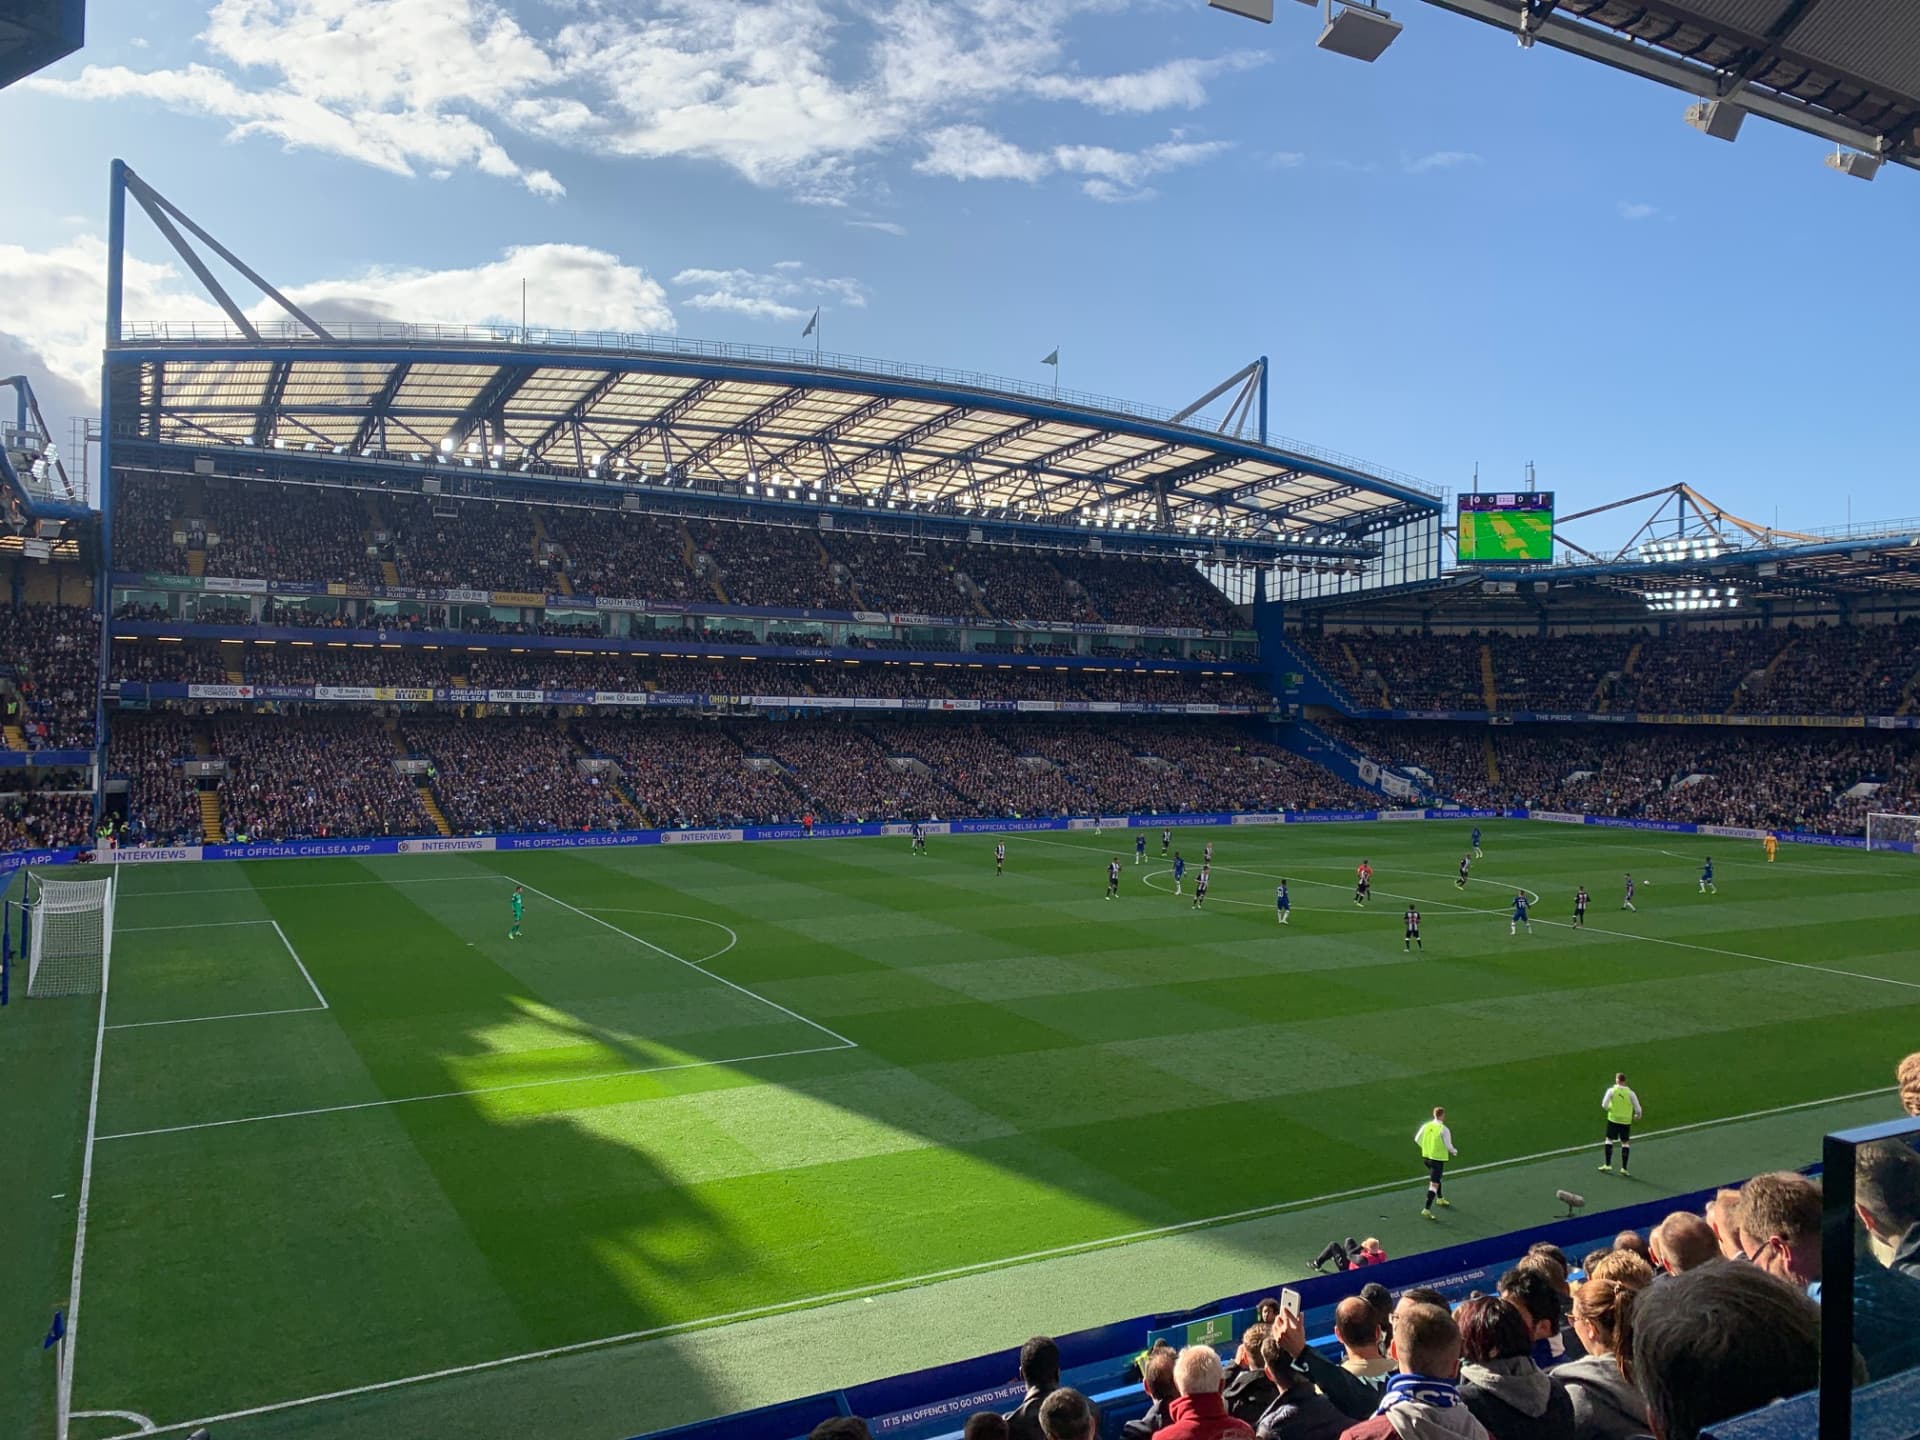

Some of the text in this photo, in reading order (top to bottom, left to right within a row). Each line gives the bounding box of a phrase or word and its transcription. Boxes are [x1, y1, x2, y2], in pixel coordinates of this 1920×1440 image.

[597, 598, 623, 606] SOUTH
[625, 599, 645, 608] WEST
[900, 616, 922, 624] MALTA
[709, 695, 728, 703] OHIO
[681, 832, 732, 841] INTERVIEWS
[1797, 836, 1831, 845] OFFICIAL
[422, 841, 482, 850] INTERVIEWS
[513, 840, 531, 848] THE
[533, 838, 575, 847] OFFICIAL
[578, 837, 618, 846] CHELSEA
[114, 850, 186, 861] INTERVIEWS
[223, 844, 370, 857] THE OFFICIAL CHELSEA APP
[30, 855, 52, 865] APP
[883, 1418, 891, 1428] IT
[892, 1417, 900, 1426] IS
[902, 1414, 913, 1423] AN
[913, 1404, 947, 1420] OFFENCE
[948, 1402, 959, 1411] TO
[960, 1398, 972, 1408] GO
[973, 1393, 993, 1404] ONTO
[995, 1389, 1009, 1399] THE
